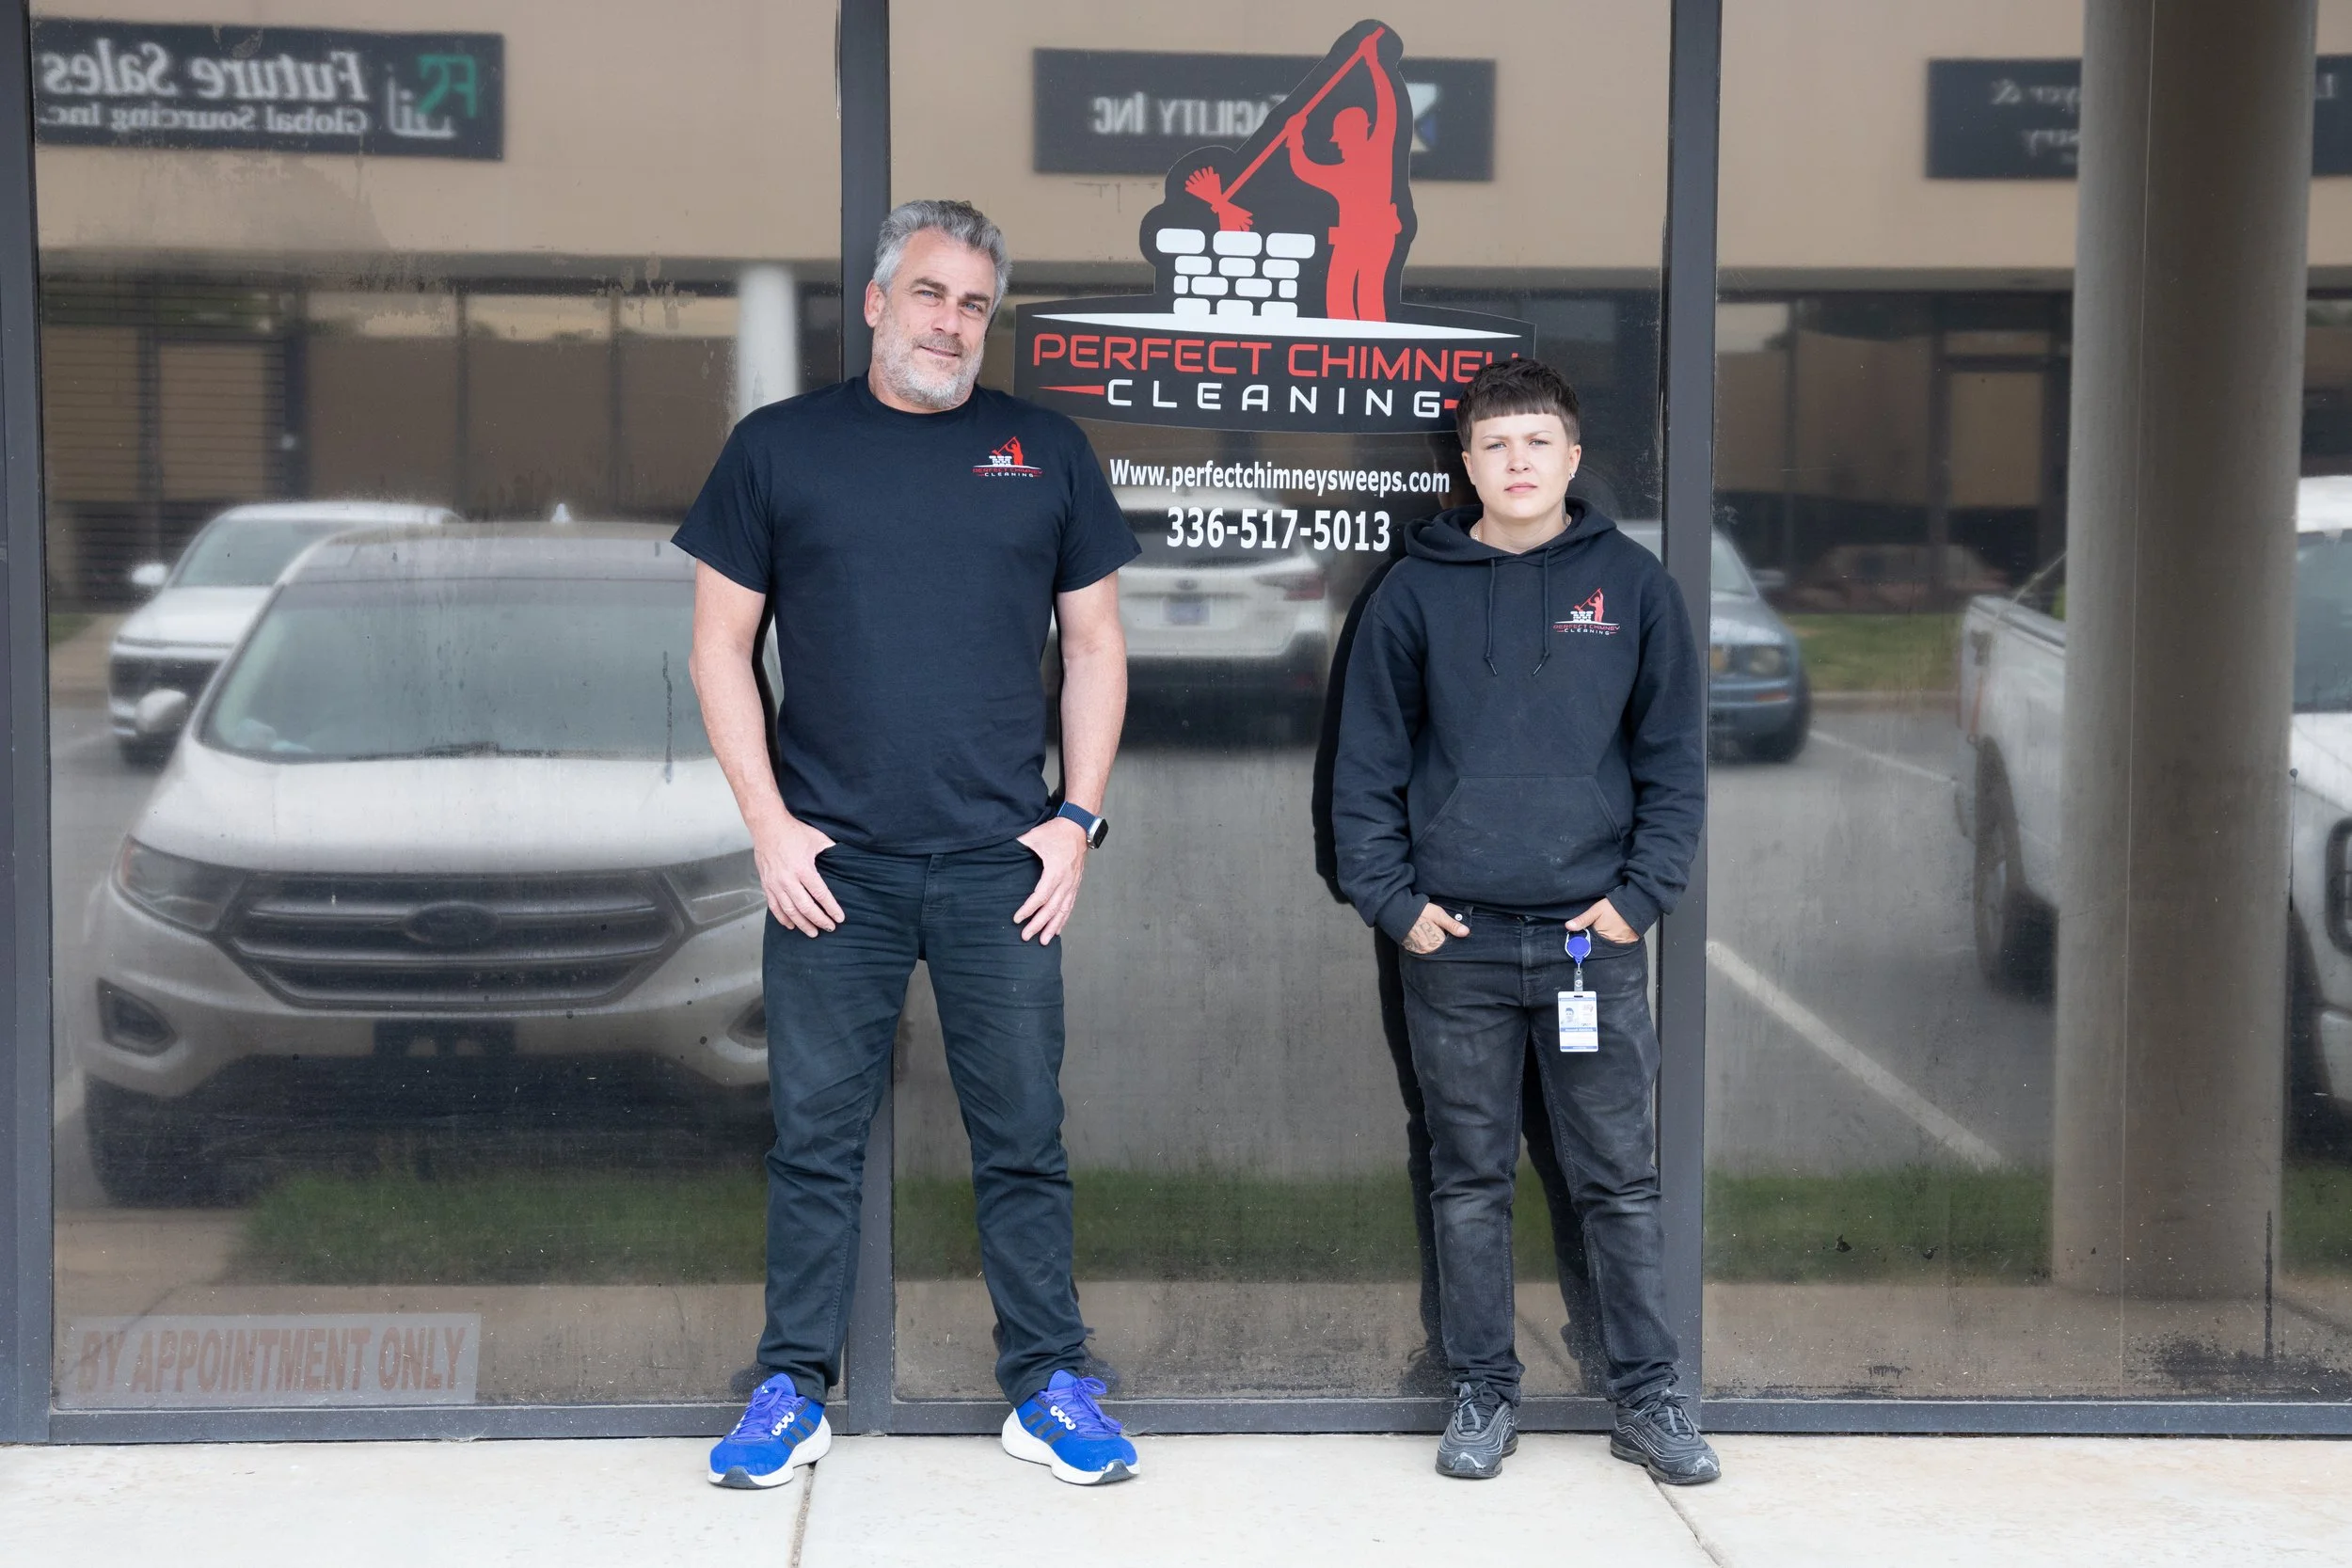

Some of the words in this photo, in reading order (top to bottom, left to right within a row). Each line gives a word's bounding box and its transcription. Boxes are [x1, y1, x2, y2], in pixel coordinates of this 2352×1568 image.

[1033, 332, 1273, 376] PERFECT
[1106, 379, 1441, 420] CLEANING
[1109, 458, 1451, 498] Www.perfectchimneysweeps.com
[1166, 505, 1391, 552] 336-517-5013
[1564, 627, 1610, 636] CLEANING
[79, 1329, 128, 1394] BY
[130, 1326, 373, 1394] APPOINTMENT
[377, 1325, 469, 1392] ONLY
